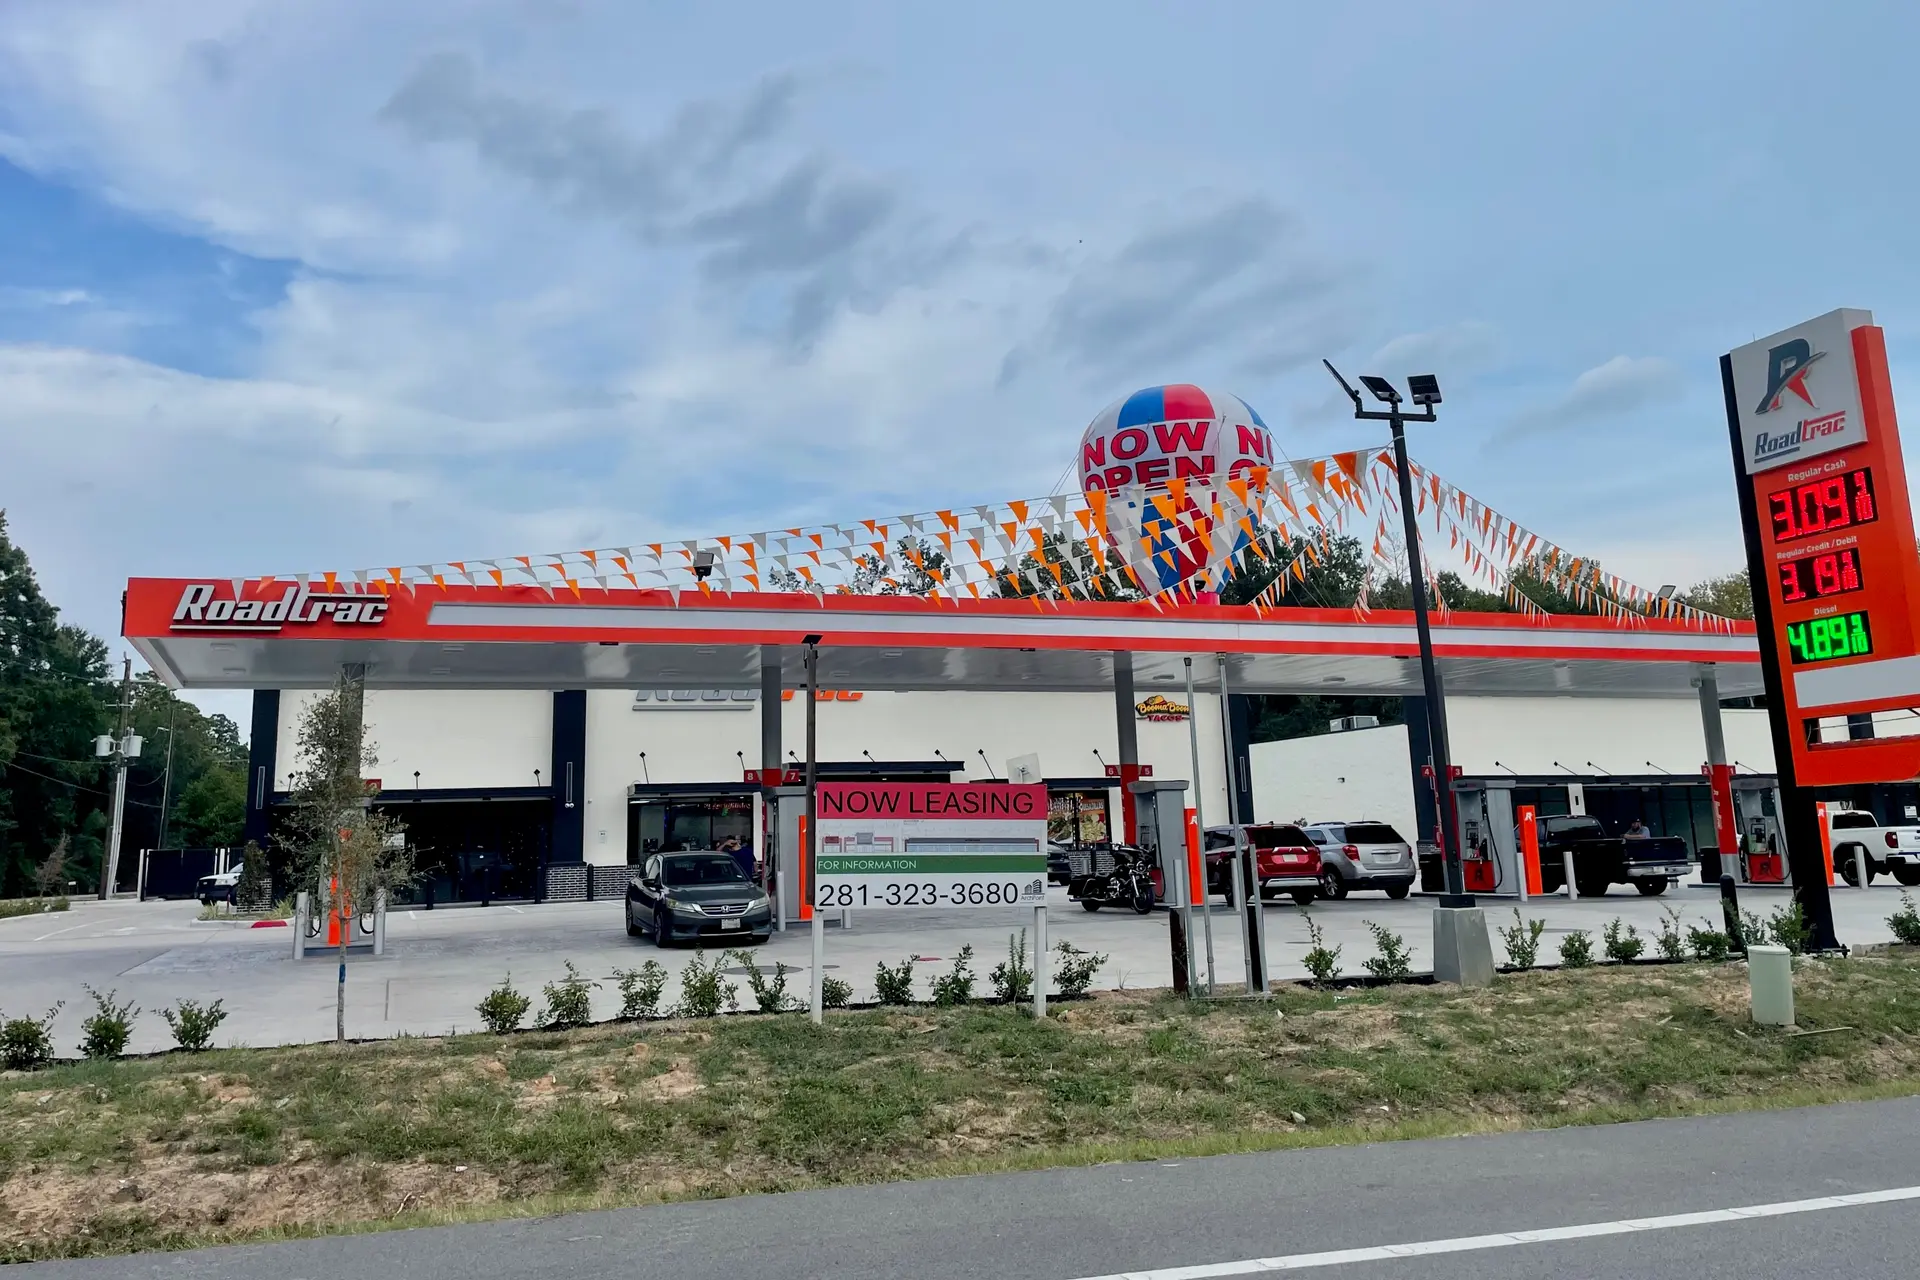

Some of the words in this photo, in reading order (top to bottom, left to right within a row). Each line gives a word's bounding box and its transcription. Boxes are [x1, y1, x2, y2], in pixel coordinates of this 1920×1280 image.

[1753, 410, 1846, 456] Roadtrac
[1083, 421, 1210, 473] NOW
[1084, 455, 1216, 498] OPEN
[1787, 467, 1822, 483] Regular
[1823, 459, 1847, 472] Cash
[1769, 476, 1851, 541] 3.09
[1776, 548, 1806, 559] Regular
[1806, 541, 1830, 553] Credit
[172, 584, 390, 623] Roadtrac
[1813, 605, 1838, 616] Diesel
[1787, 616, 1850, 660] 4.89
[1146, 714, 1183, 722] TACOS
[747, 772, 754, 781] 8
[789, 772, 797, 781] 7
[1108, 767, 1114, 775] 6
[1144, 767, 1150, 775] 5
[1423, 768, 1430, 776] 4
[1455, 768, 1461, 776] 3
[1703, 767, 1709, 775] 2
[1730, 767, 1735, 775] 1
[823, 791, 900, 814] NOW
[909, 791, 1034, 814] LEASING
[818, 860, 840, 870] FOR
[842, 860, 917, 870] INFORMATION
[819, 882, 1019, 907] 281-323-3680
